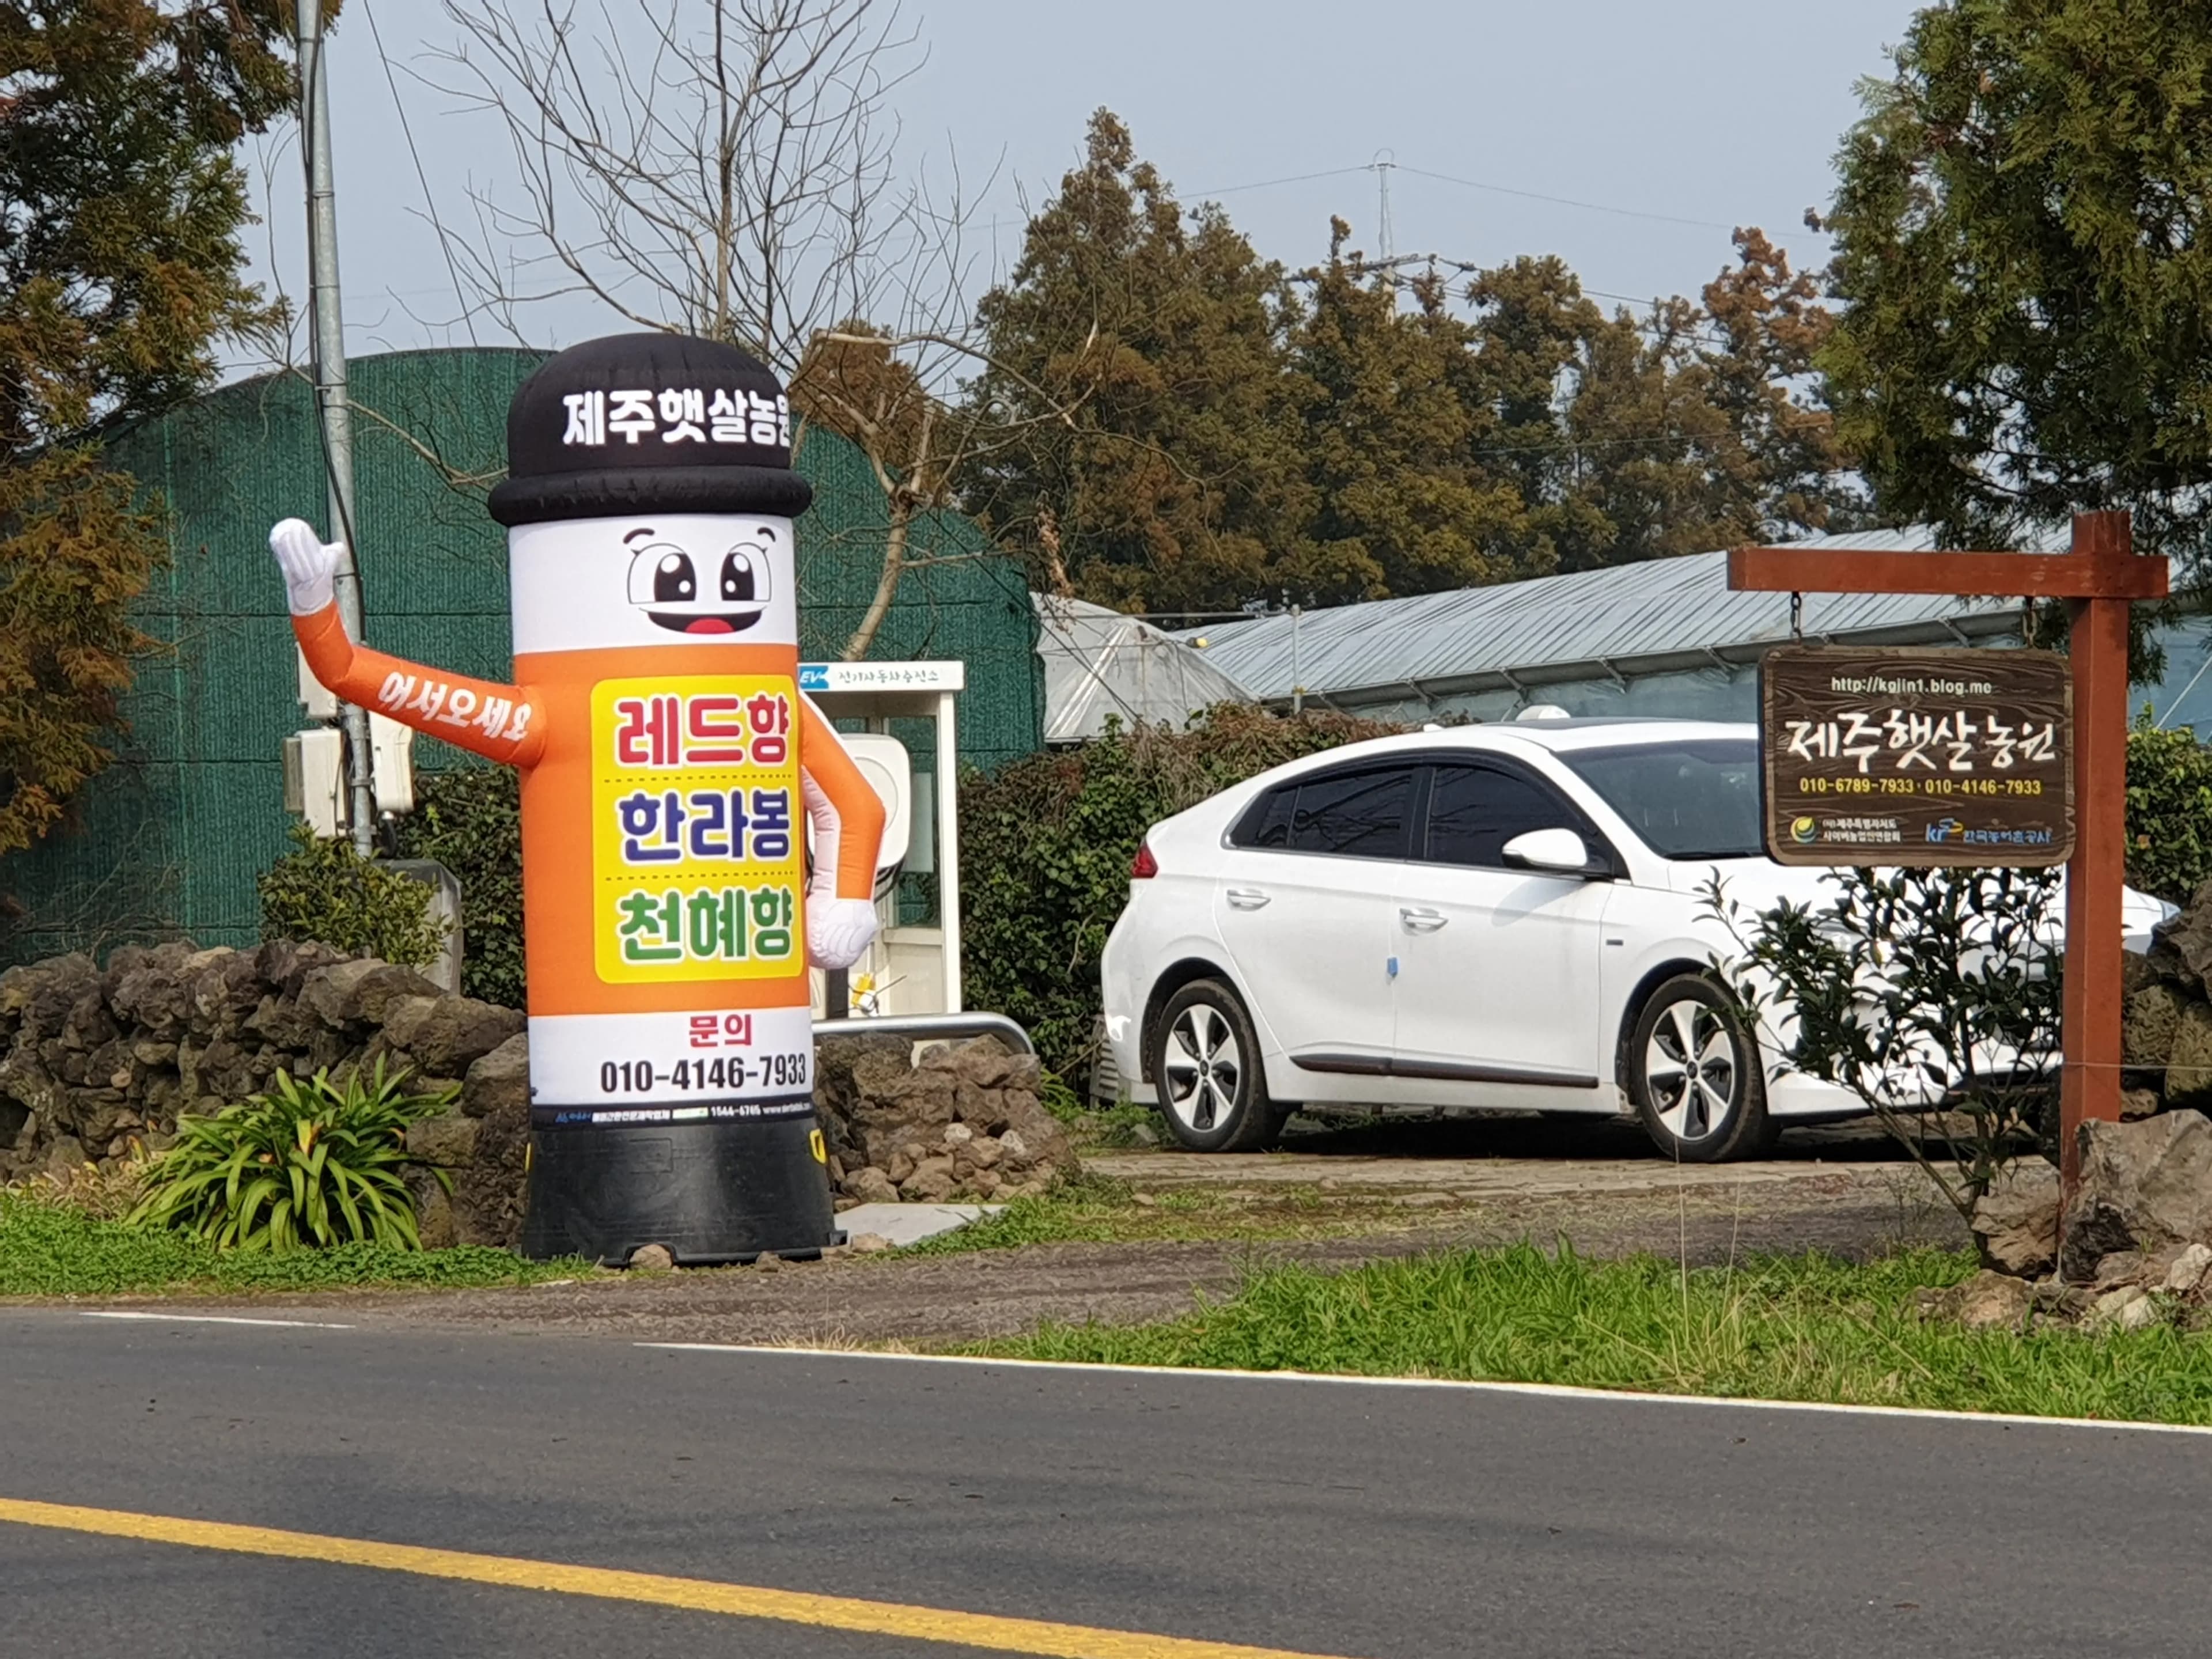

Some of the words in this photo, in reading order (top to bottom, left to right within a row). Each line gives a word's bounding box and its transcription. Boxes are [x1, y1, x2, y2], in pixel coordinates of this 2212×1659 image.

[800, 671, 817, 684] EV
[1831, 676, 1992, 695] http://kgjin1.blog.me
[378, 671, 532, 742] 어서오세요
[617, 693, 790, 766] 레드향
[1800, 778, 1914, 793] 010-6789-7933
[1925, 779, 2041, 795] 010-4146-7933
[618, 789, 790, 862] 한라봉
[620, 887, 792, 960] 천혜향
[689, 1014, 751, 1047] 문의
[600, 1053, 806, 1093] 010-4146-7933
